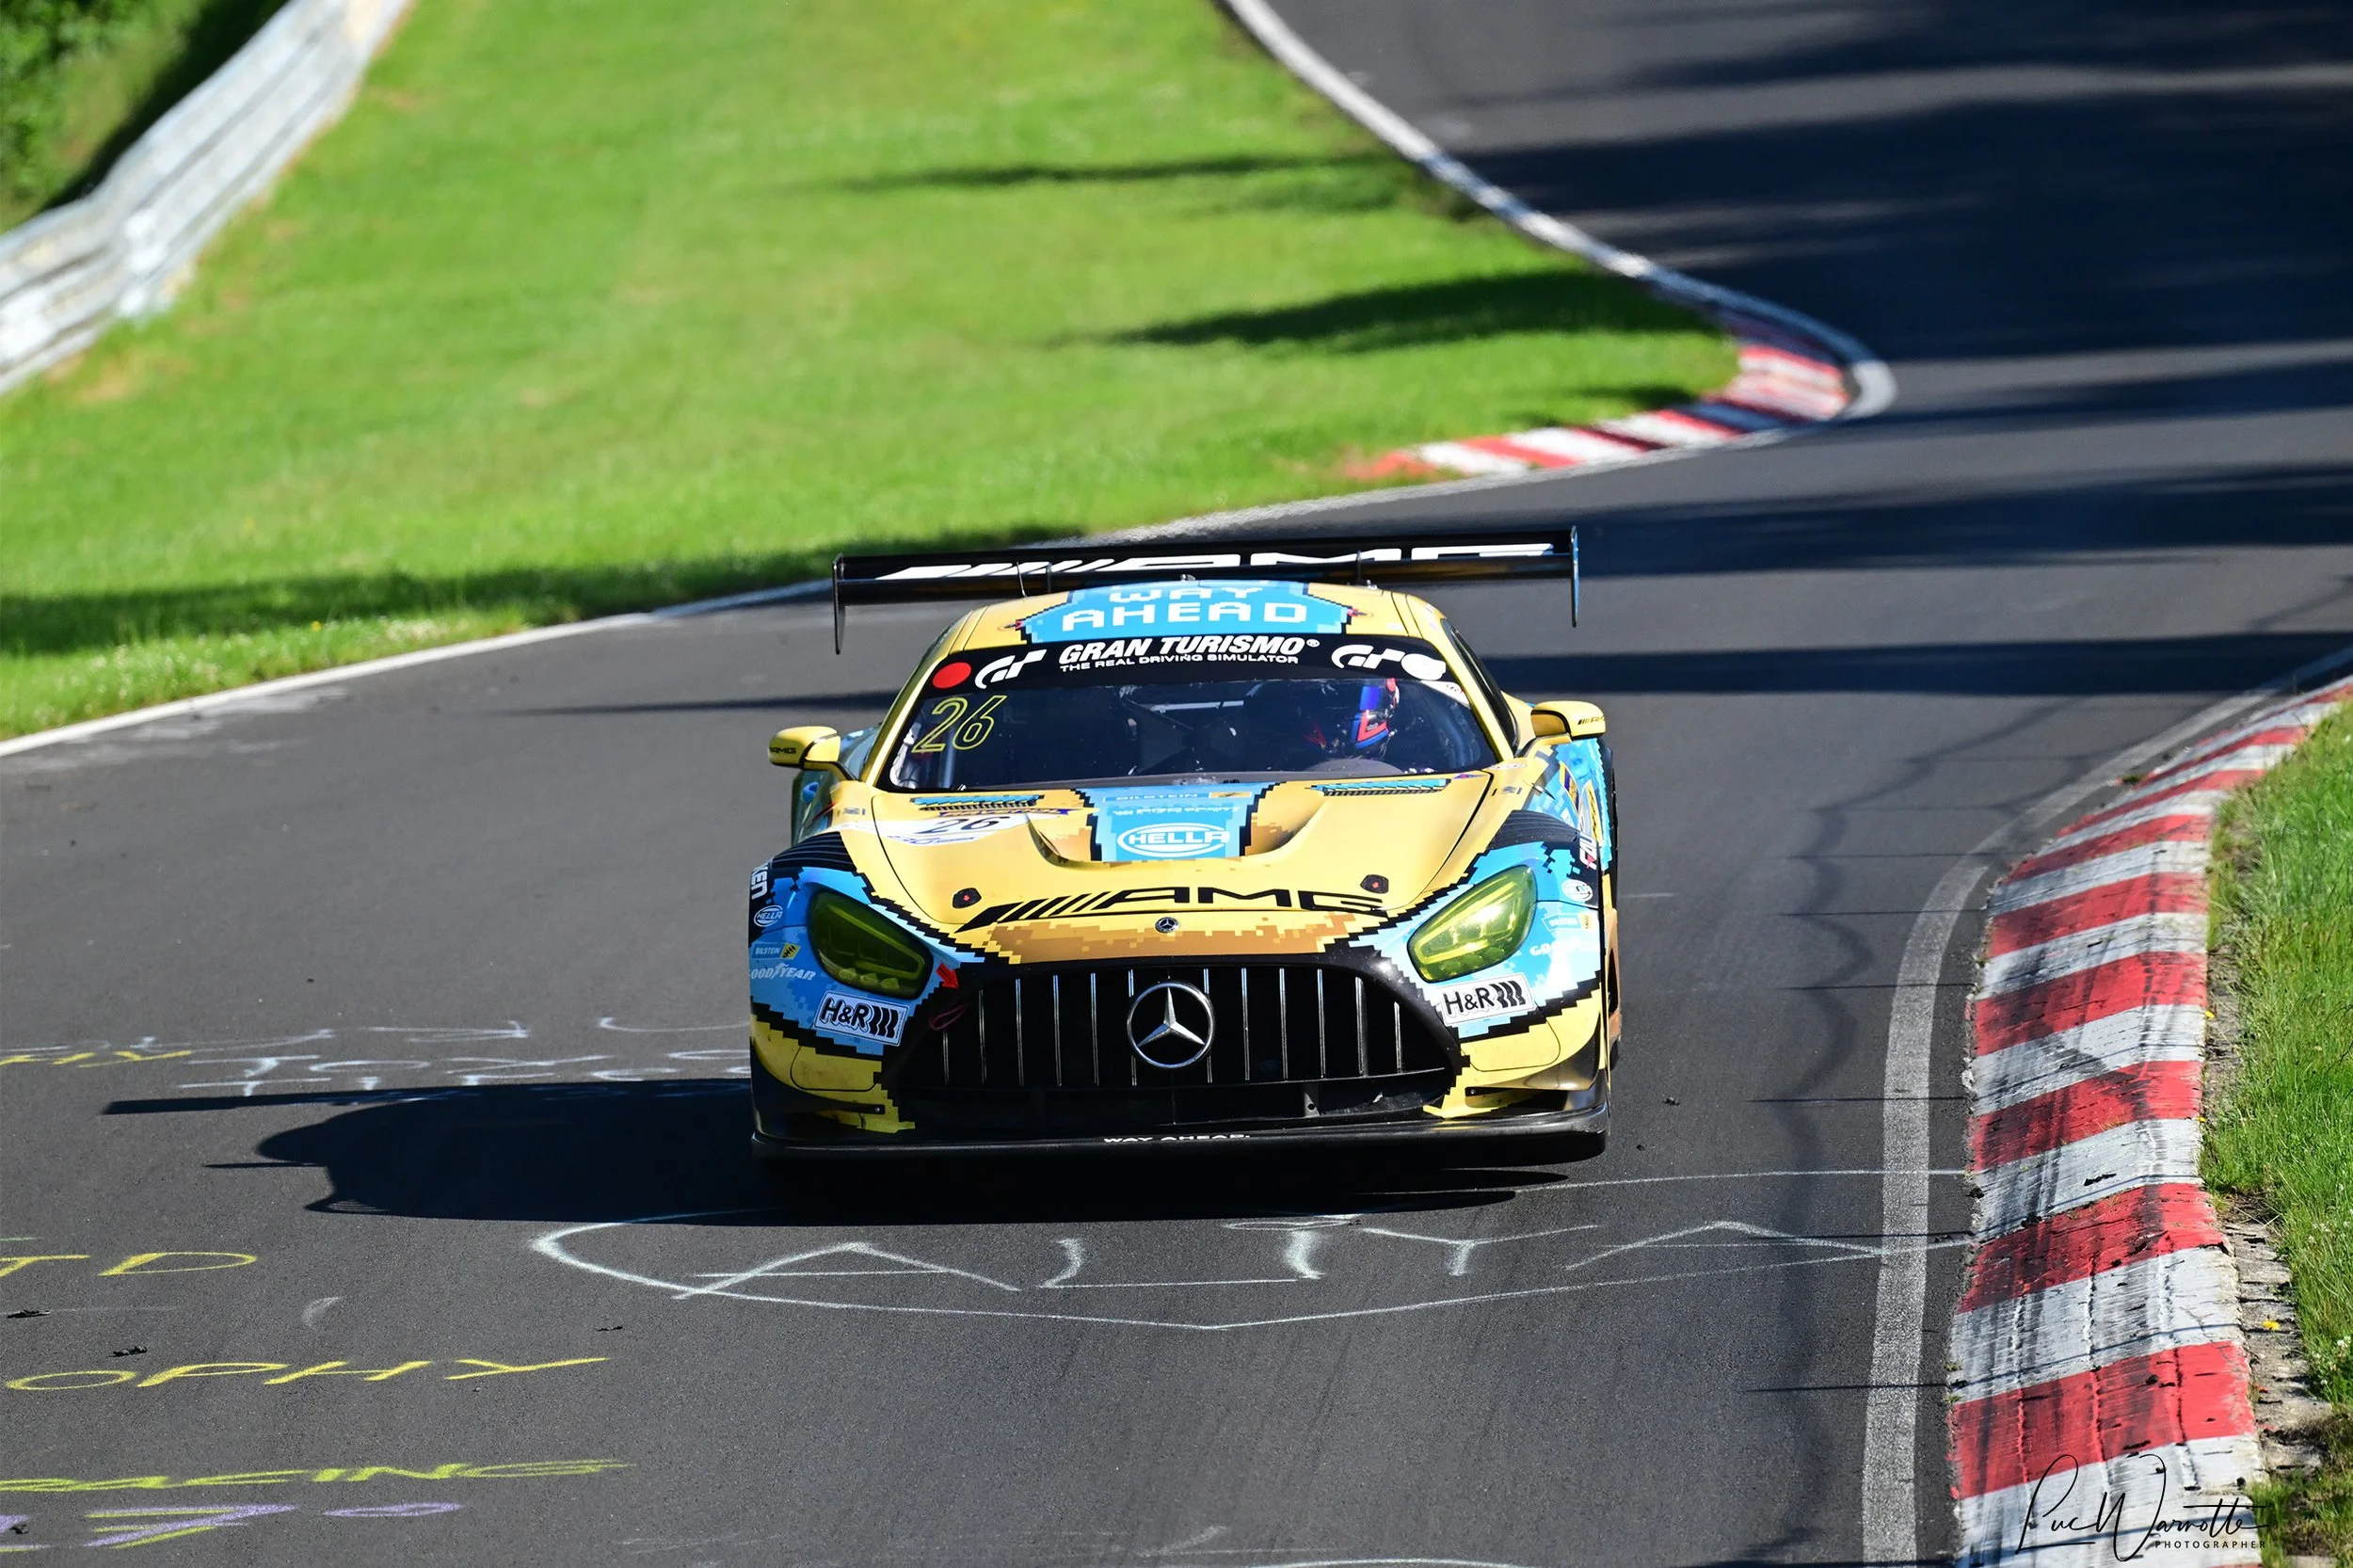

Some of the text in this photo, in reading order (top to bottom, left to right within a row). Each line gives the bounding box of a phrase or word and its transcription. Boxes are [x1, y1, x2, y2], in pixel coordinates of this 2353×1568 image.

[1109, 586, 1263, 603] WAY
[1062, 602, 1307, 632] AHEAD
[1059, 638, 1153, 664] GRAN
[1060, 653, 1298, 672] THE REAL DRIVING SIMULATOR
[911, 695, 1007, 754] 26
[916, 816, 1011, 835] 26
[1128, 830, 1230, 845] HELLA
[1091, 887, 1388, 917] AMG
[755, 947, 780, 955] BILSTEIN
[1443, 987, 1495, 1015] H&R
[819, 998, 872, 1032] H&R
